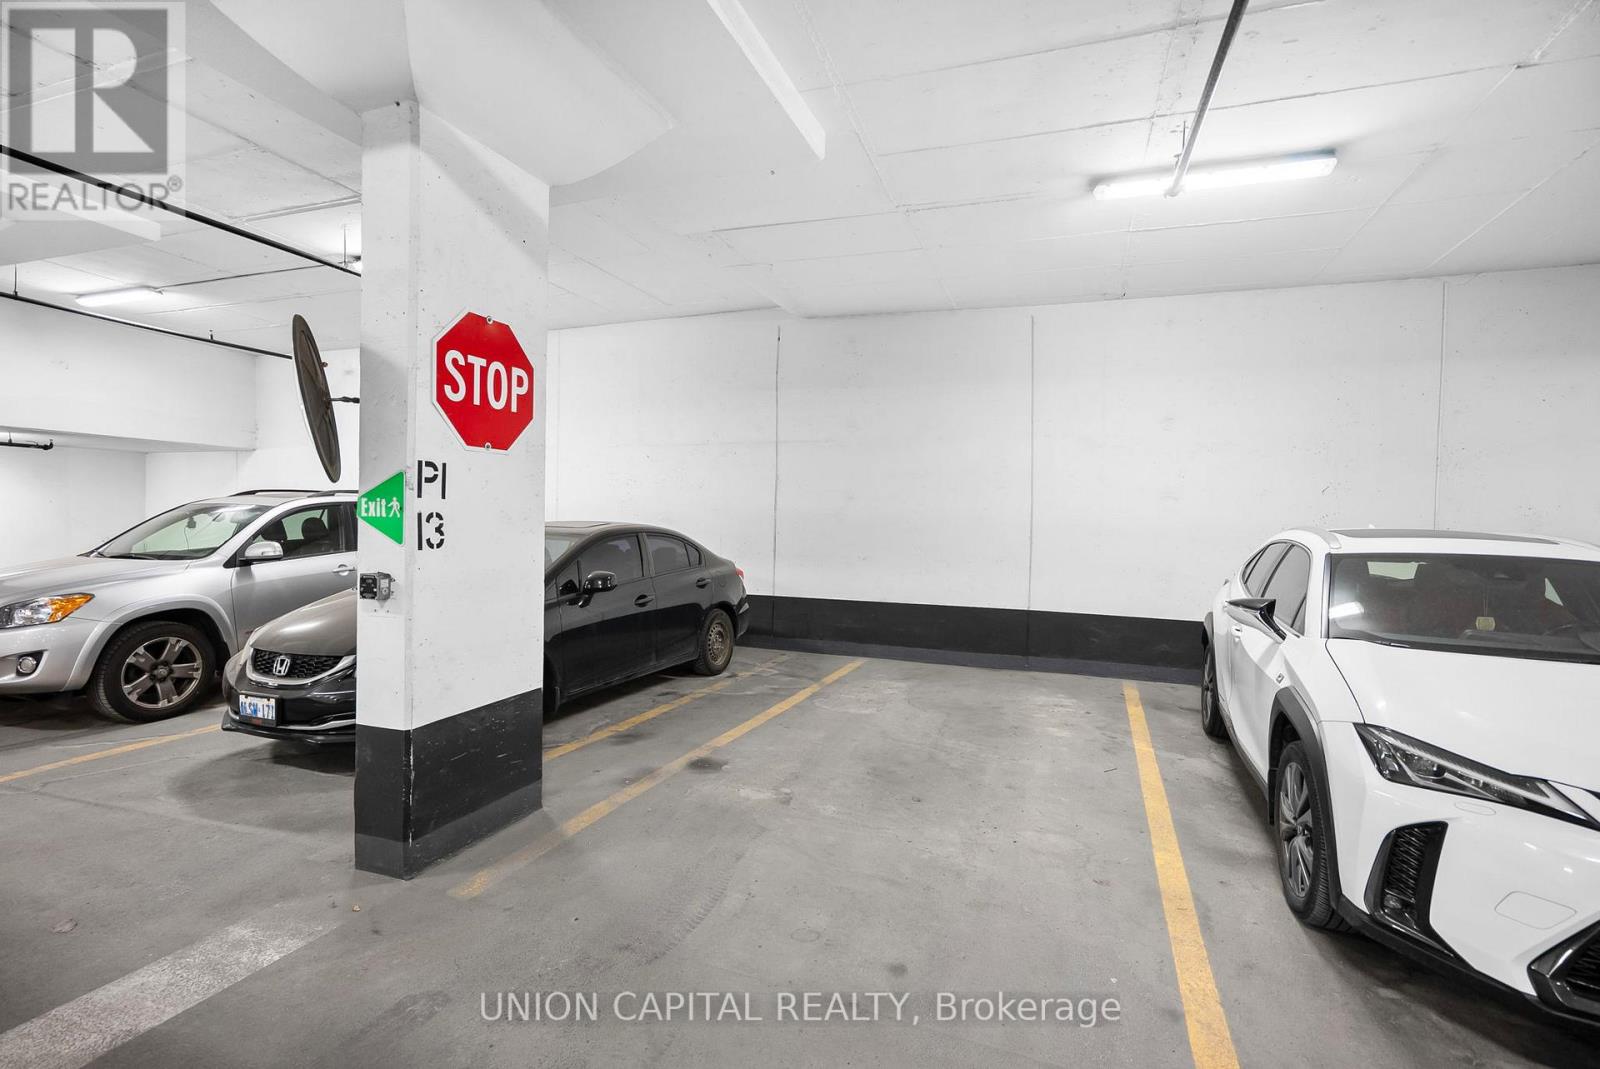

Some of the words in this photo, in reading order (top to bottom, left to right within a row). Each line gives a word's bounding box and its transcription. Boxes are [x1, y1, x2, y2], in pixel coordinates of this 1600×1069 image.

[443, 349, 530, 413] STOP
[360, 497, 387, 518] Exit
[417, 511, 446, 551] 13
